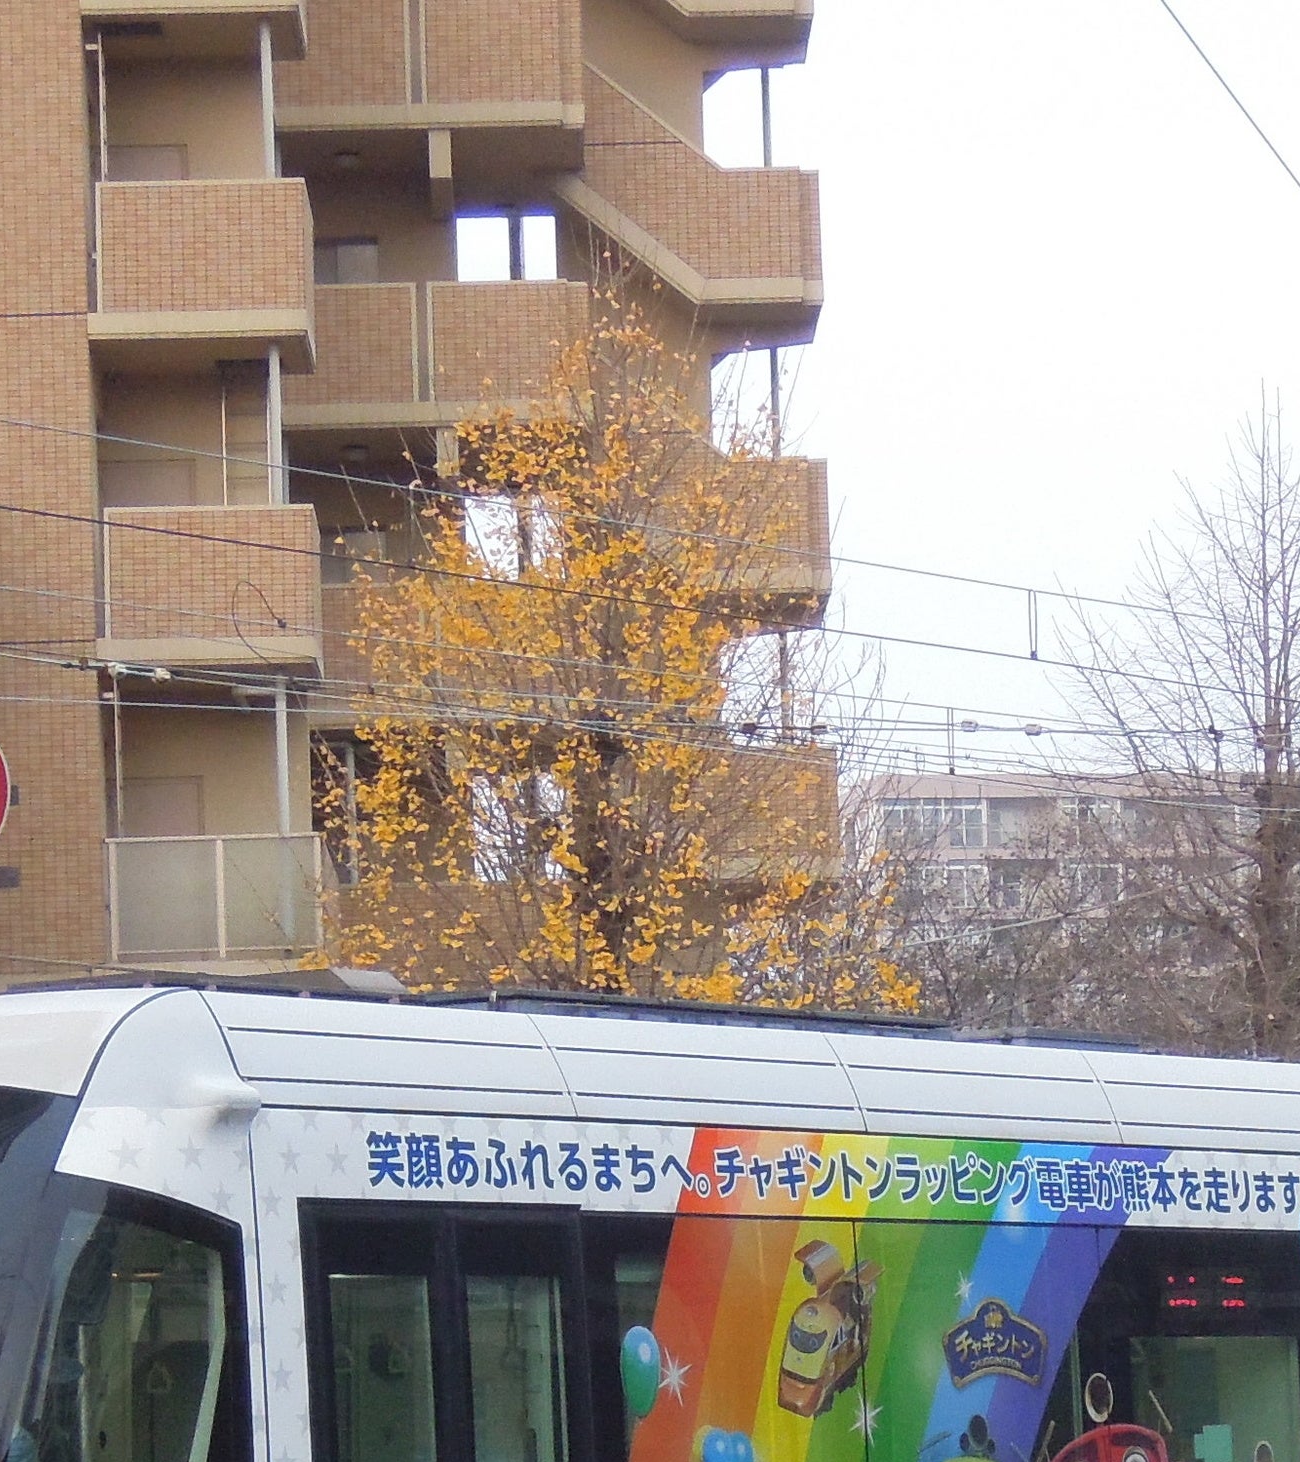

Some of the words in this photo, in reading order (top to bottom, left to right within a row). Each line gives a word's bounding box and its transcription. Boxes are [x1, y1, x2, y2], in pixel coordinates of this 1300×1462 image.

[955, 1330, 1035, 1364] チャギントン
